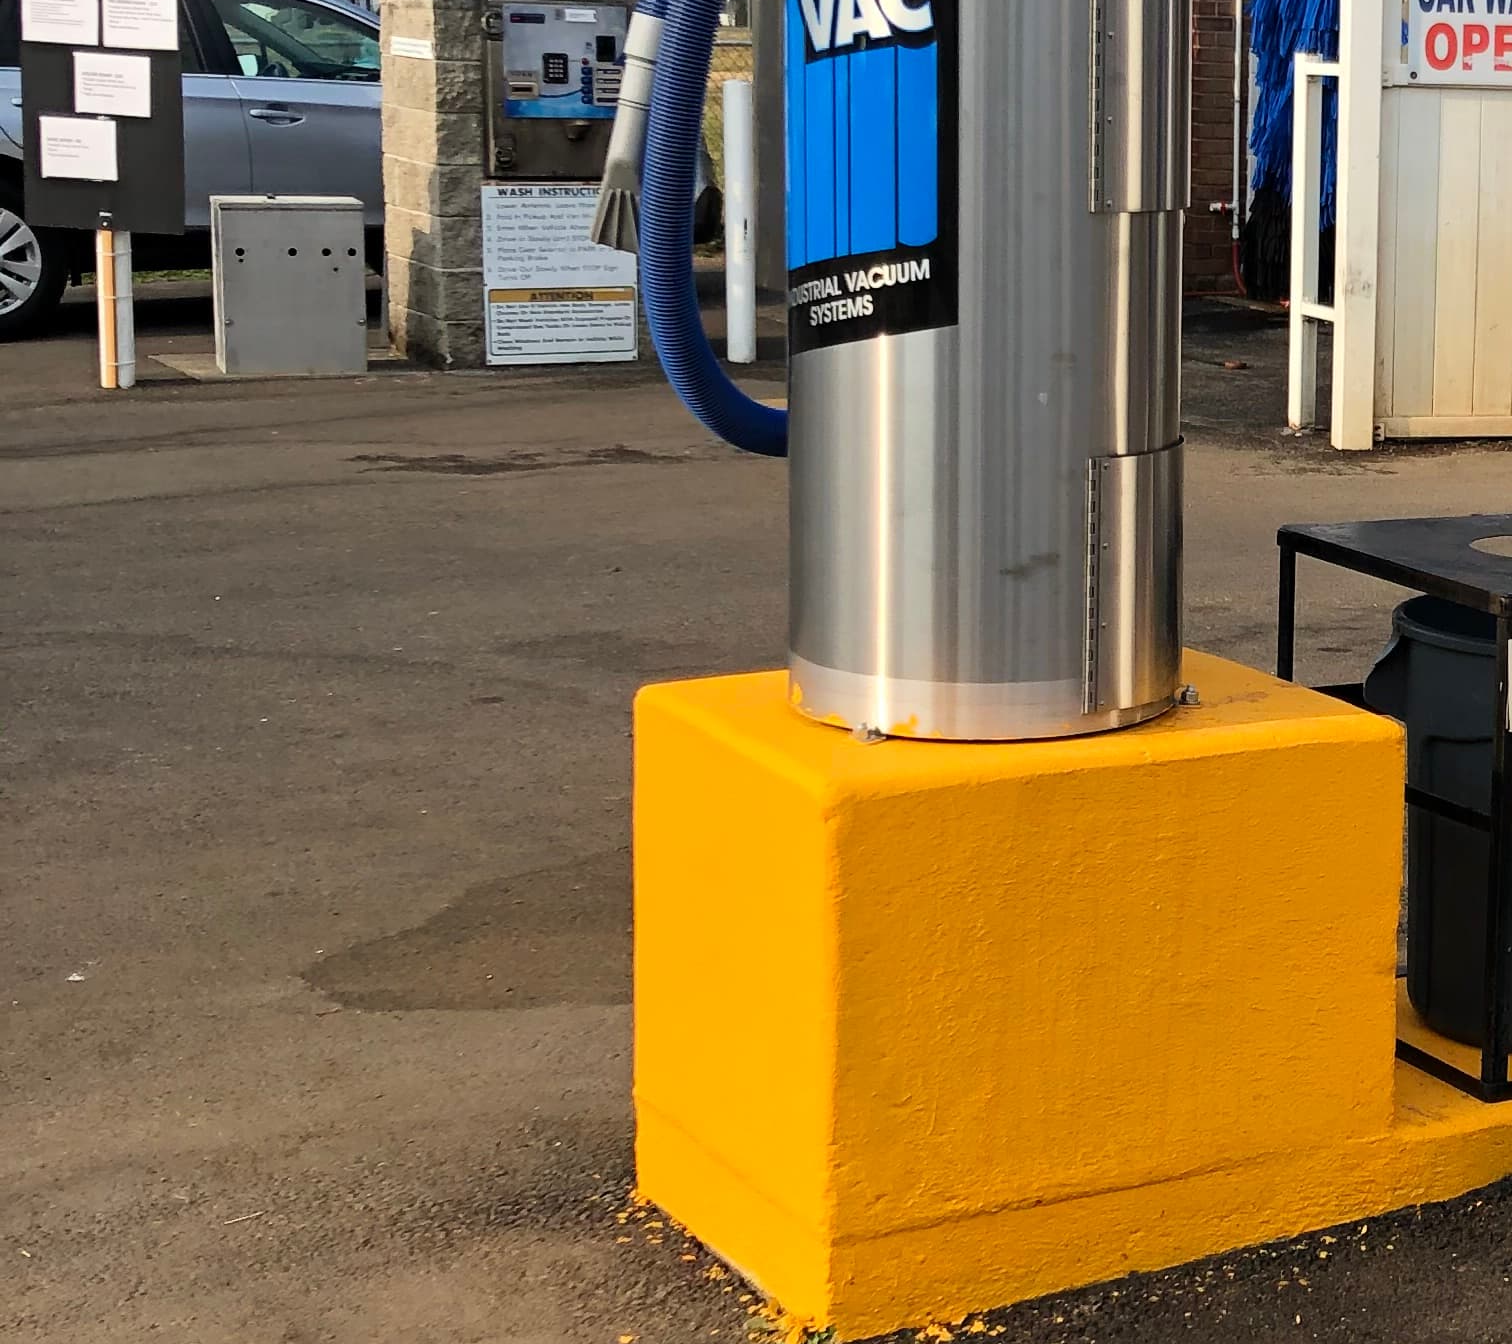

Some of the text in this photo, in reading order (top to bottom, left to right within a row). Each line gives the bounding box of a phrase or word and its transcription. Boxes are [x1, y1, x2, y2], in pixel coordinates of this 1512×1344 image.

[497, 187, 533, 196] WASH
[789, 258, 931, 306] DUSTRIAL VACUUM
[530, 291, 595, 301] ATTENTION
[809, 294, 874, 327] SYSTEMS
